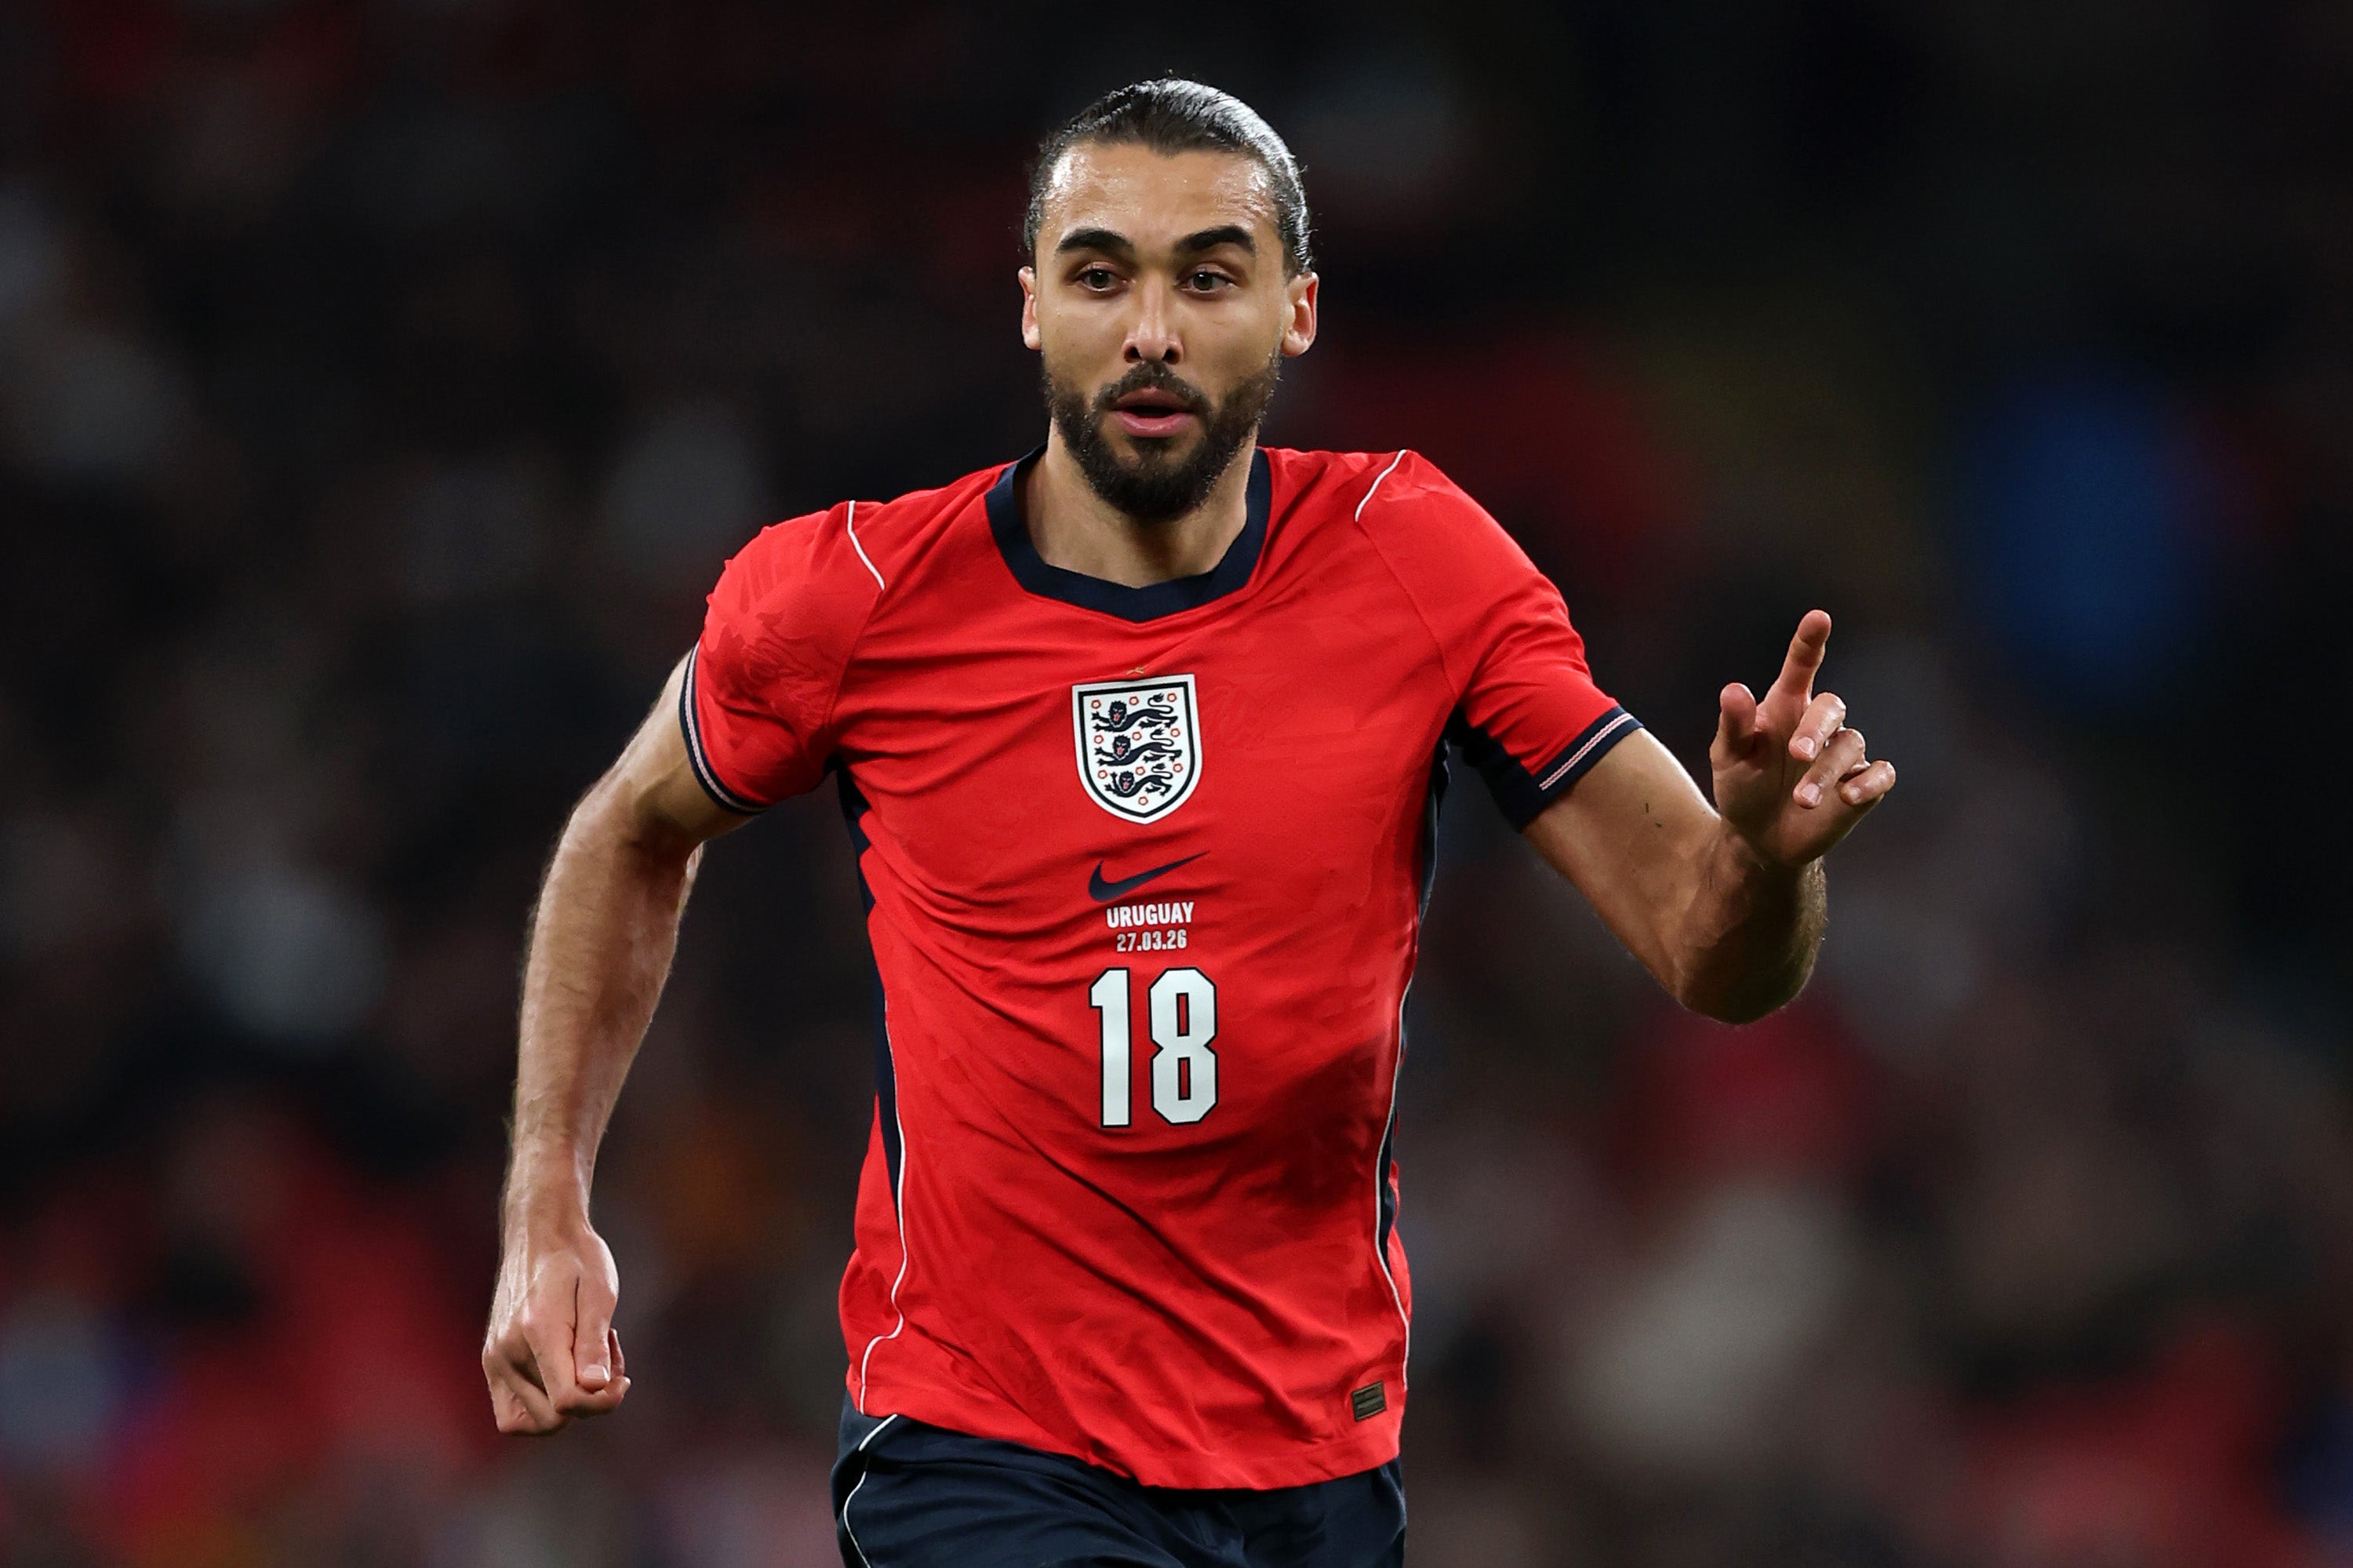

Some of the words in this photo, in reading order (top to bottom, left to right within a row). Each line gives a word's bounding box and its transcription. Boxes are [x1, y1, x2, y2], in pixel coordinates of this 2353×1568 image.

[1107, 902, 1194, 928] URUGUAY
[1116, 930, 1187, 951] 27.03.26
[1089, 967, 1218, 1127] 18
